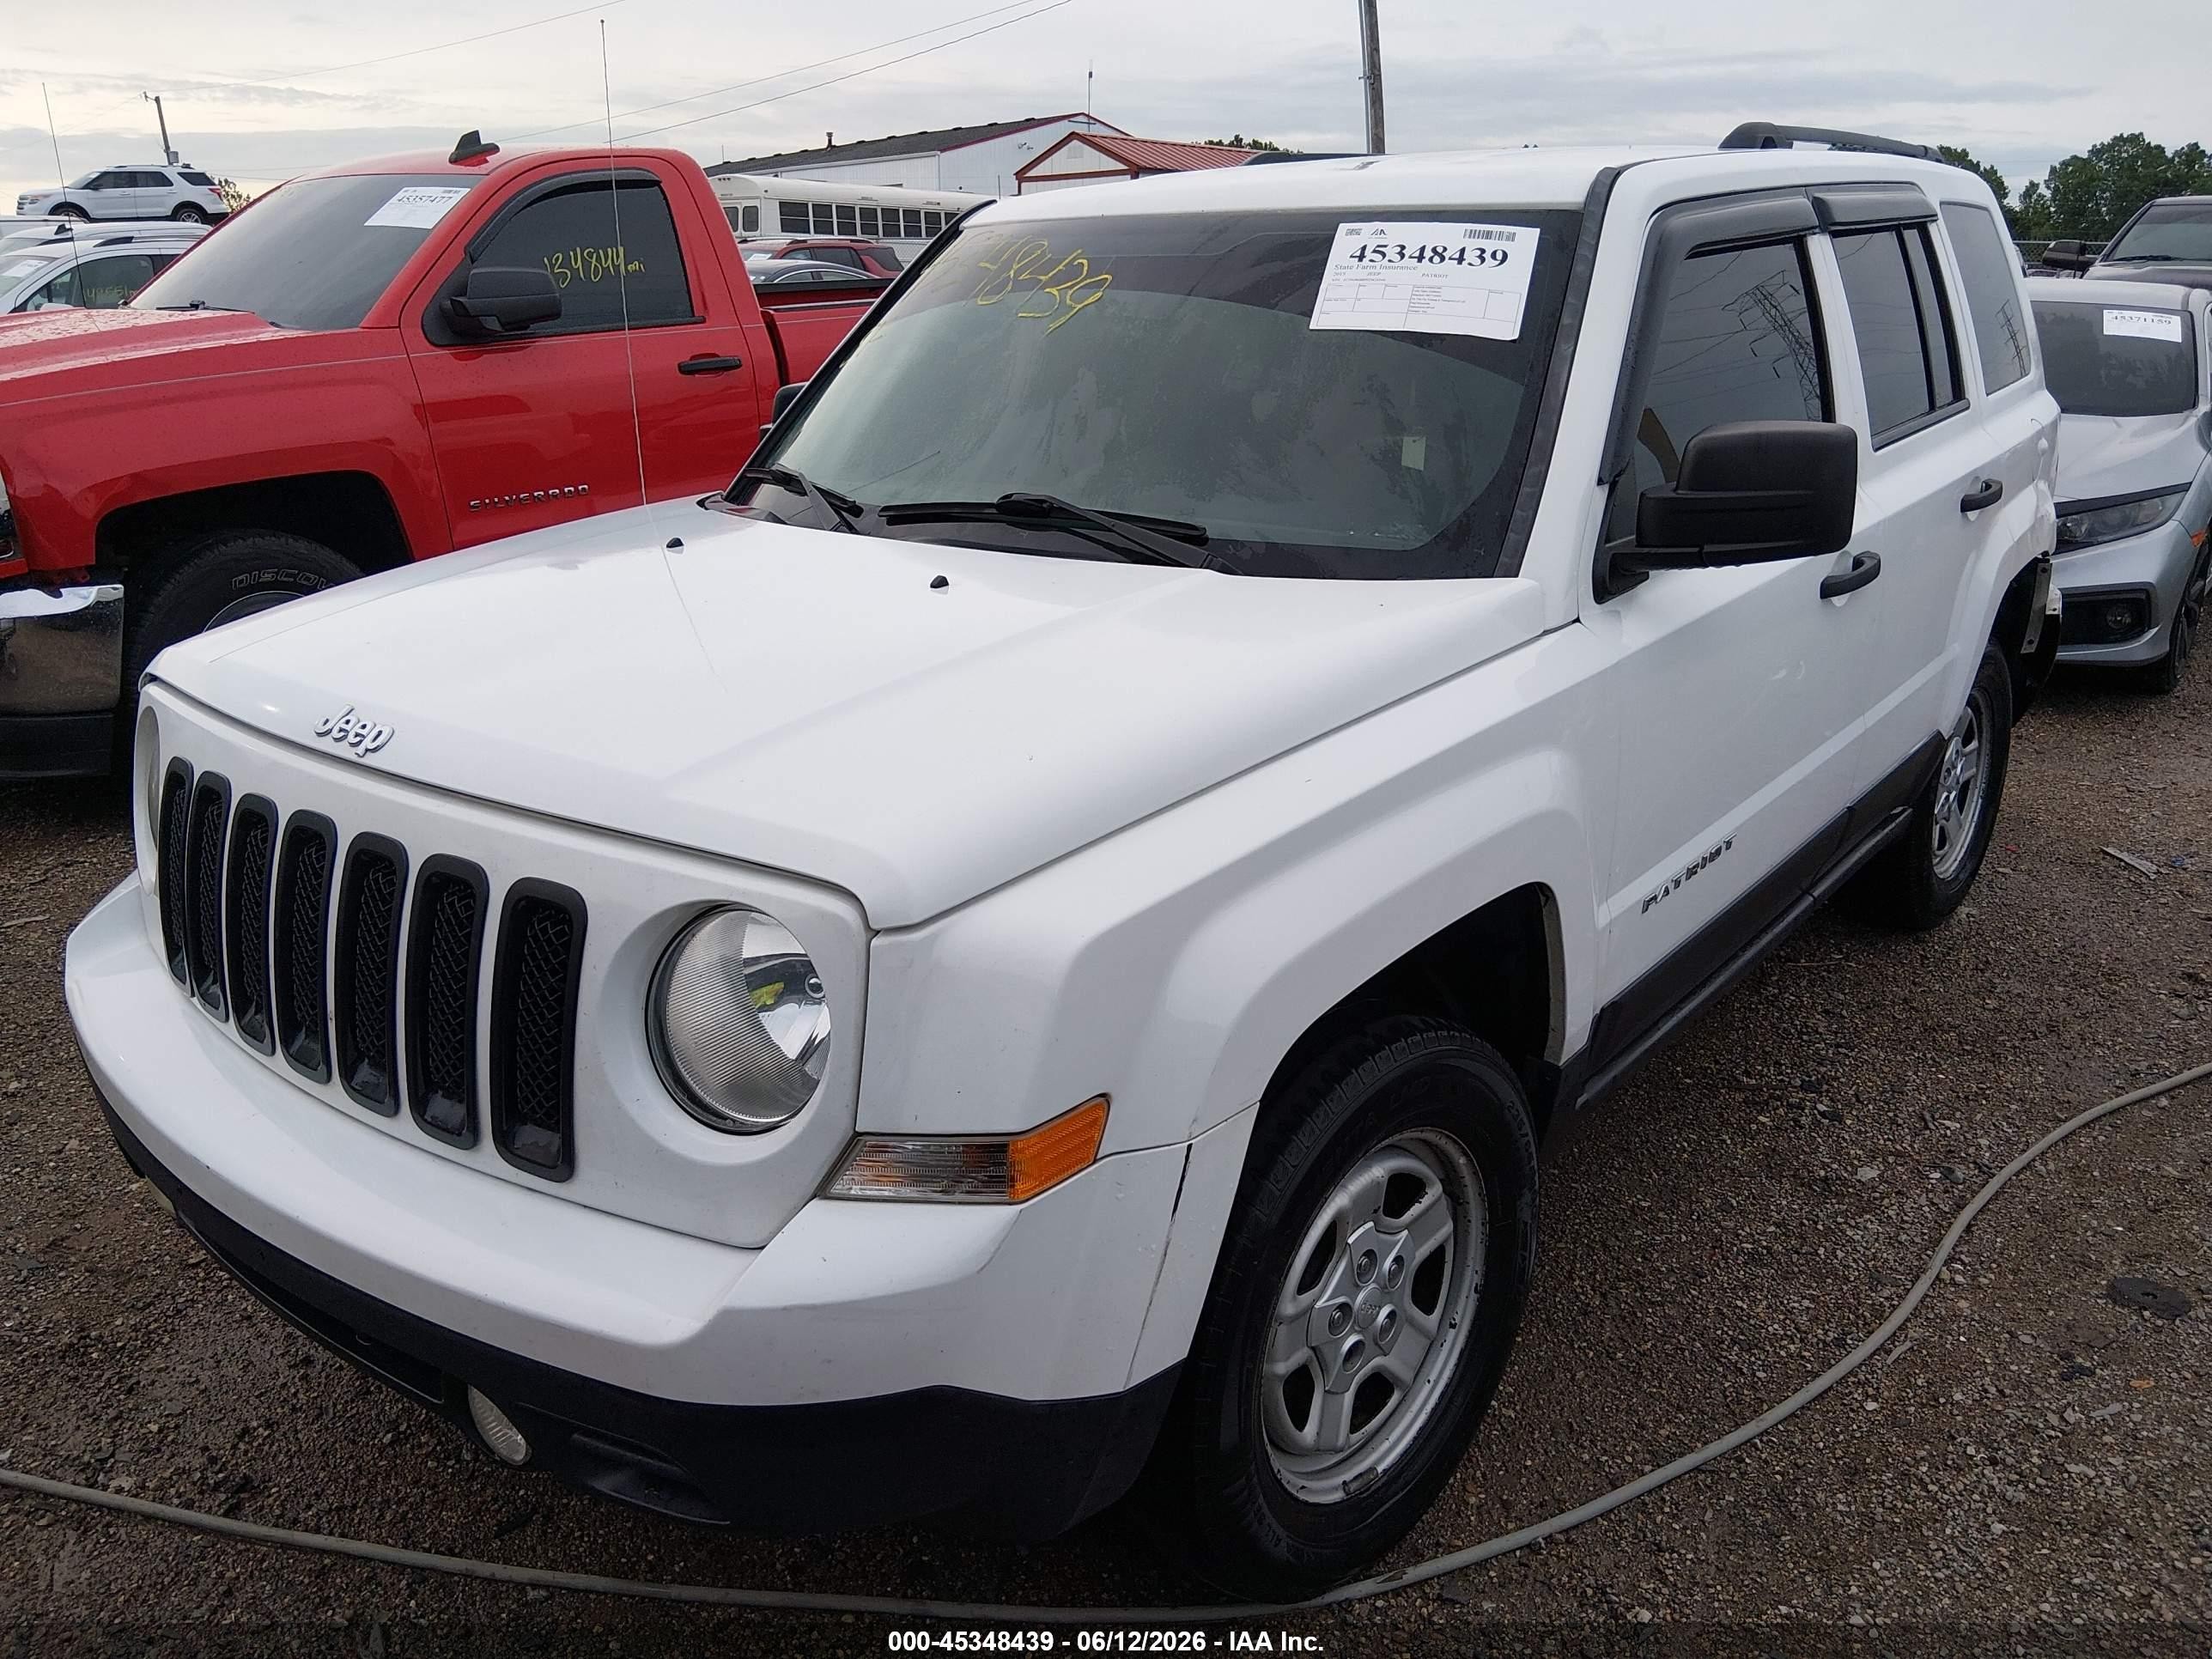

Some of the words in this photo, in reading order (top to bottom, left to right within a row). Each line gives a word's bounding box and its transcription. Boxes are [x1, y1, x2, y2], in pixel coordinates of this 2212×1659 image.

[1349, 244, 1509, 268] 45348439
[468, 484, 590, 512] SILVERADO
[313, 703, 395, 757] Jeep
[1641, 831, 1738, 915] PATRIOT
